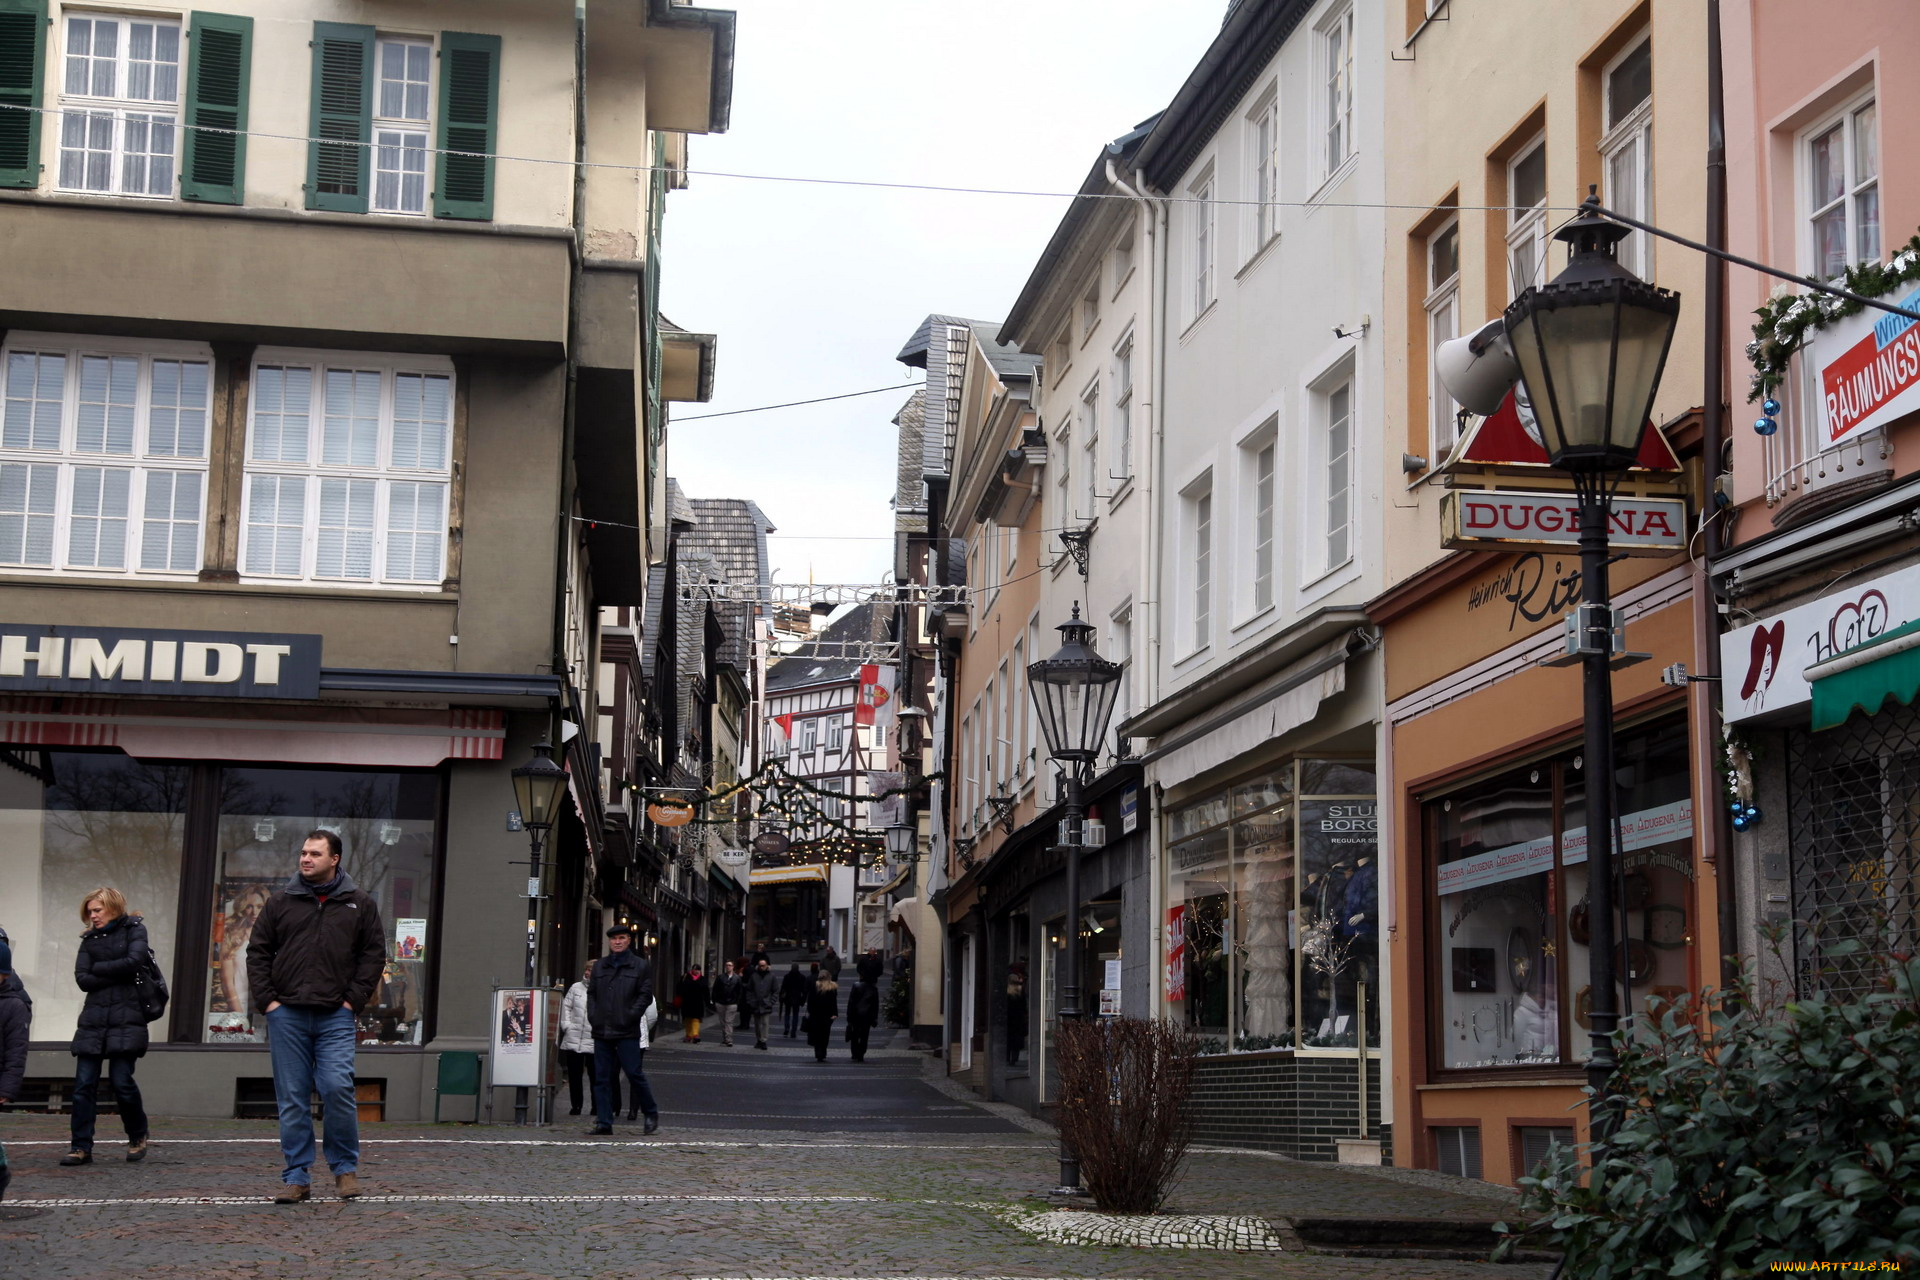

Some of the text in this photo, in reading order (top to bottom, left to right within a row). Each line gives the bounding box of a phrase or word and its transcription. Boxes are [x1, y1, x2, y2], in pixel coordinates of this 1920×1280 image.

[1826, 329, 1920, 435] RÄUMUNGS
[1467, 567, 1513, 612] Heinrich
[1807, 598, 1884, 663] Herz
[1644, 813, 1676, 830] DUGENA
[1442, 867, 1465, 881] DUGENA
[1471, 860, 1494, 874] DUGENA
[1500, 852, 1525, 867] DUGENA
